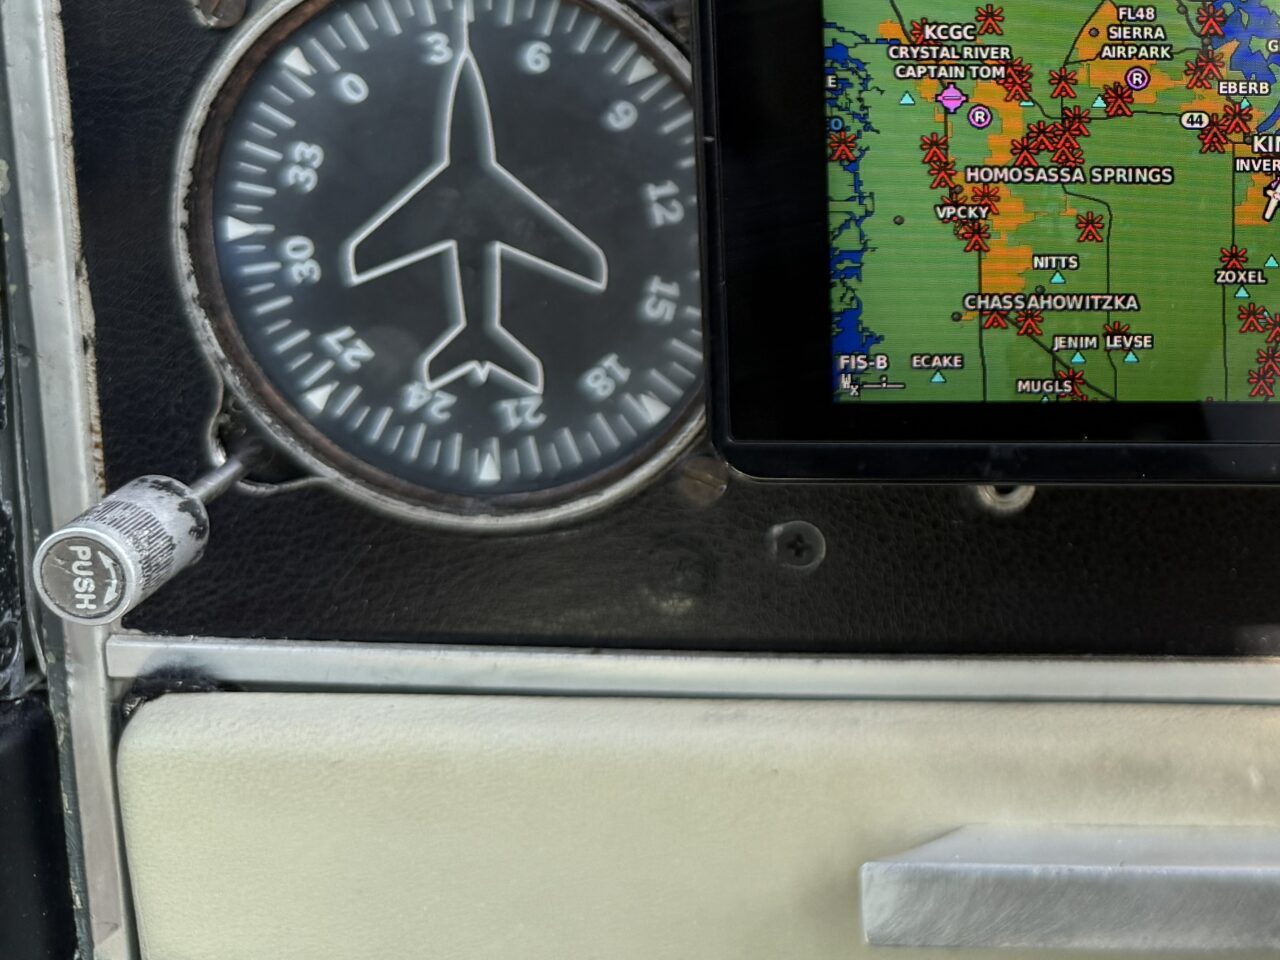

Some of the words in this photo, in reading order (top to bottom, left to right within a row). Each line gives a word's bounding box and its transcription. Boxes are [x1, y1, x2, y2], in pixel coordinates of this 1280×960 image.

[1118, 6, 1156, 21] FL48
[924, 24, 977, 40] KCGC
[1108, 26, 1166, 40] SIERRA
[425, 32, 454, 66] 3
[888, 46, 960, 60] CRYSTAL
[963, 46, 1011, 60] RIVER
[1101, 46, 1173, 60] AIRPARK
[524, 41, 554, 74] 6
[895, 65, 966, 79] CAPTAIN
[969, 65, 1006, 79] TOM
[1219, 82, 1270, 94] EBERB
[1185, 114, 1205, 127] 44
[965, 167, 1085, 183] HOMOSASSA
[1090, 167, 1174, 183] SPRINGS
[936, 206, 990, 219] VPCKY
[1033, 256, 1079, 269] NITTS
[1216, 270, 1267, 284] ZOXEL
[964, 295, 1139, 311] CHASSAHOWITZKA
[1052, 336, 1098, 351] JENIM
[1105, 335, 1153, 349] LEVSE
[839, 354, 889, 370] FIS-B
[911, 355, 963, 368] ECAKE
[1017, 380, 1073, 393] MUGLS
[68, 544, 97, 610] PUSH
